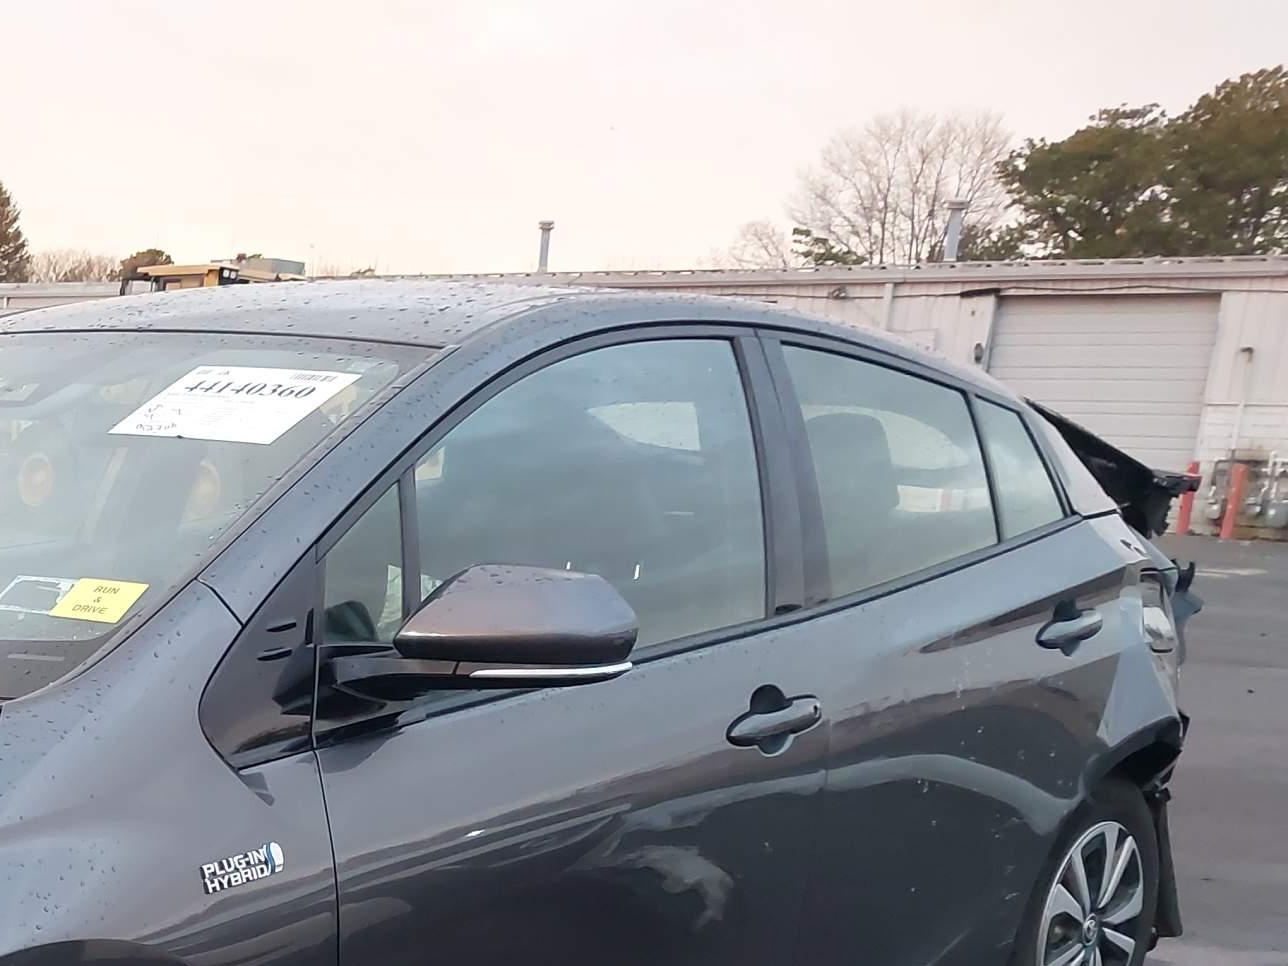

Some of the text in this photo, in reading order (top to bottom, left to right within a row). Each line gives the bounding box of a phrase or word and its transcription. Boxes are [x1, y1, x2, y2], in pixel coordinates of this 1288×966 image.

[184, 380, 317, 399] 44140360
[93, 586, 120, 595] RUN
[72, 604, 108, 615] DRIVE
[202, 848, 266, 879] PLUG-IN
[205, 864, 269, 894] HYBRID
